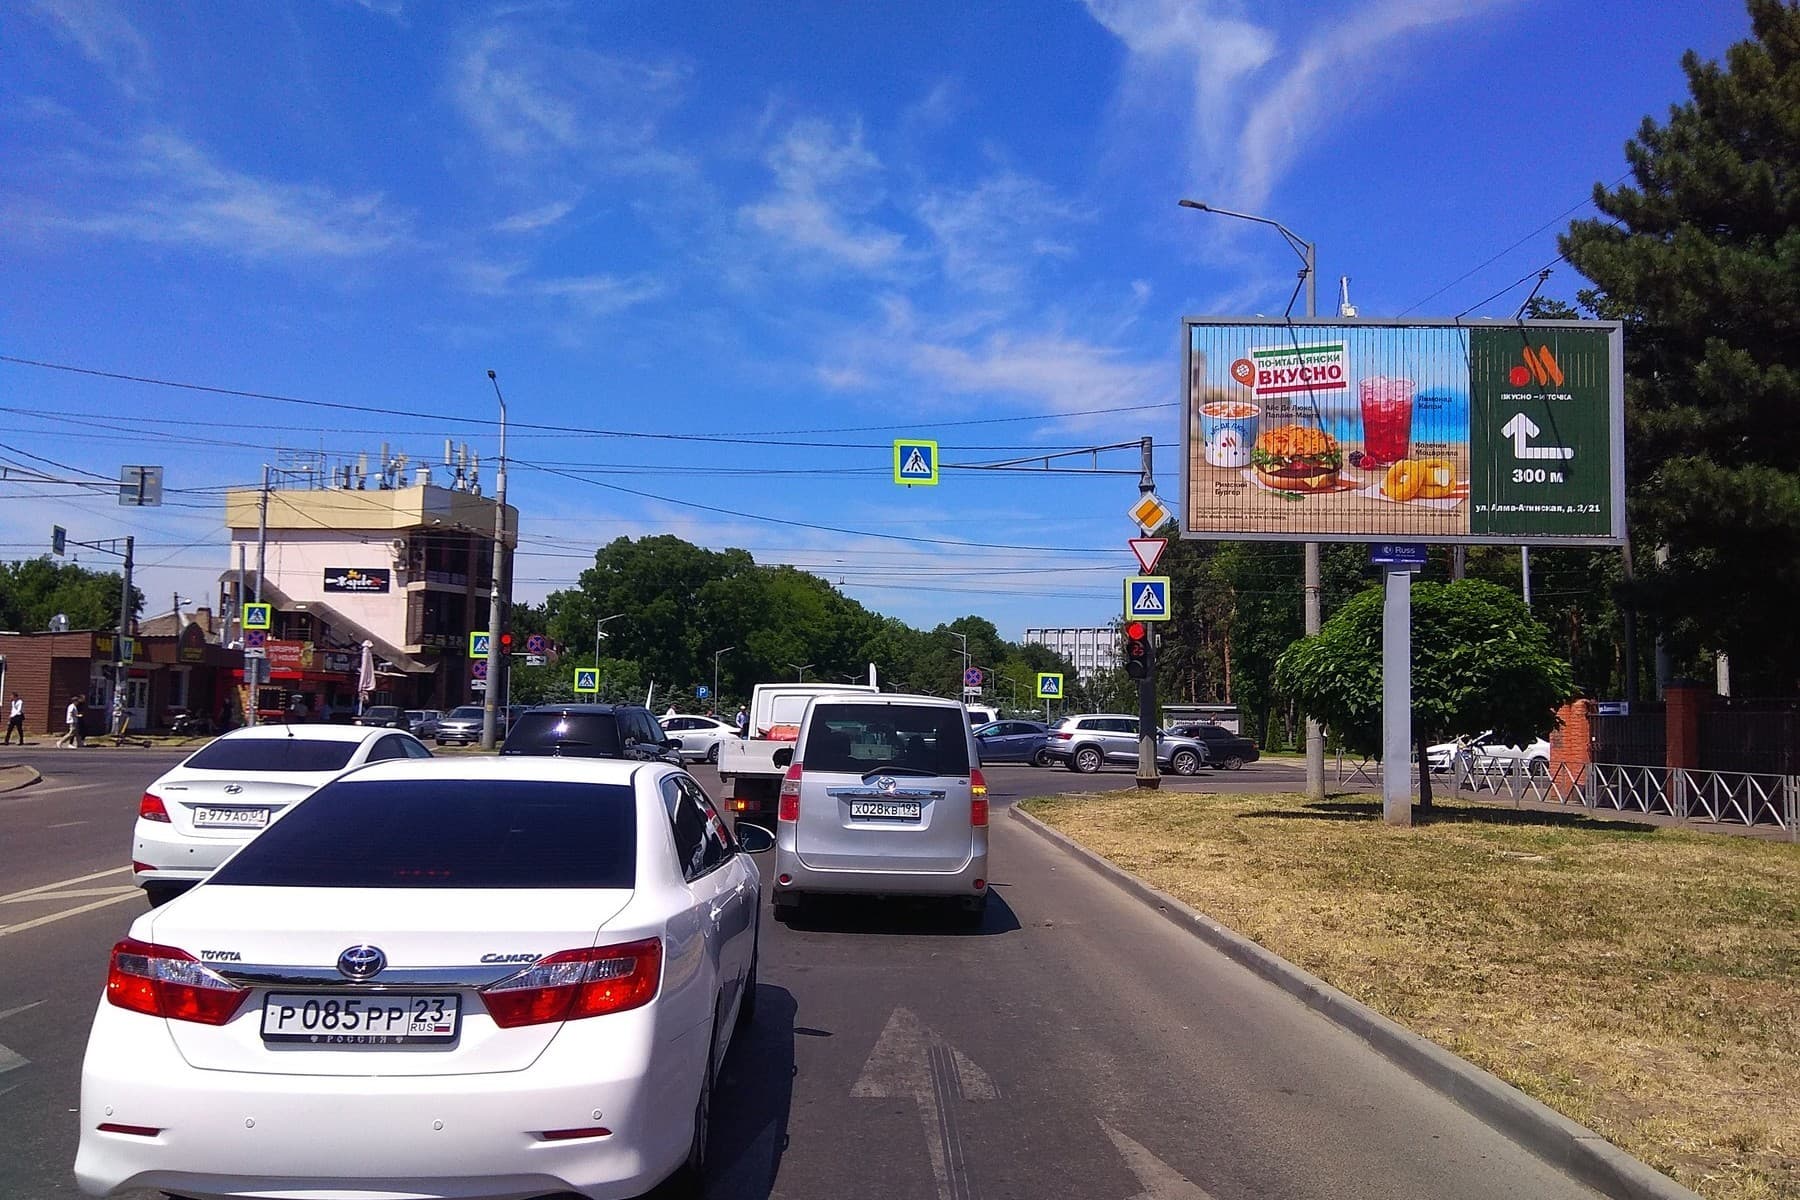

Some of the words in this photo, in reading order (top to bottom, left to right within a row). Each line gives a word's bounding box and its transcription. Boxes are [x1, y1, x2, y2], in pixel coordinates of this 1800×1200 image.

[1258, 354, 1340, 369] ПО-ИТАЛЬЯНСКИ
[1258, 365, 1342, 385] ВКУСНО
[1500, 393, 1532, 401] ВКУСНО
[1547, 393, 1573, 401] ТОЧКА
[1512, 468, 1546, 483] 300
[1577, 503, 1601, 514] 2/21
[1394, 546, 1416, 554] Russ
[900, 803, 918, 813] 193
[199, 808, 249, 821] В979АО
[200, 950, 242, 961] TOYOTA
[278, 1000, 403, 1031] Р085РР
[413, 1000, 446, 1022] 23
[409, 1022, 434, 1032] RUS
